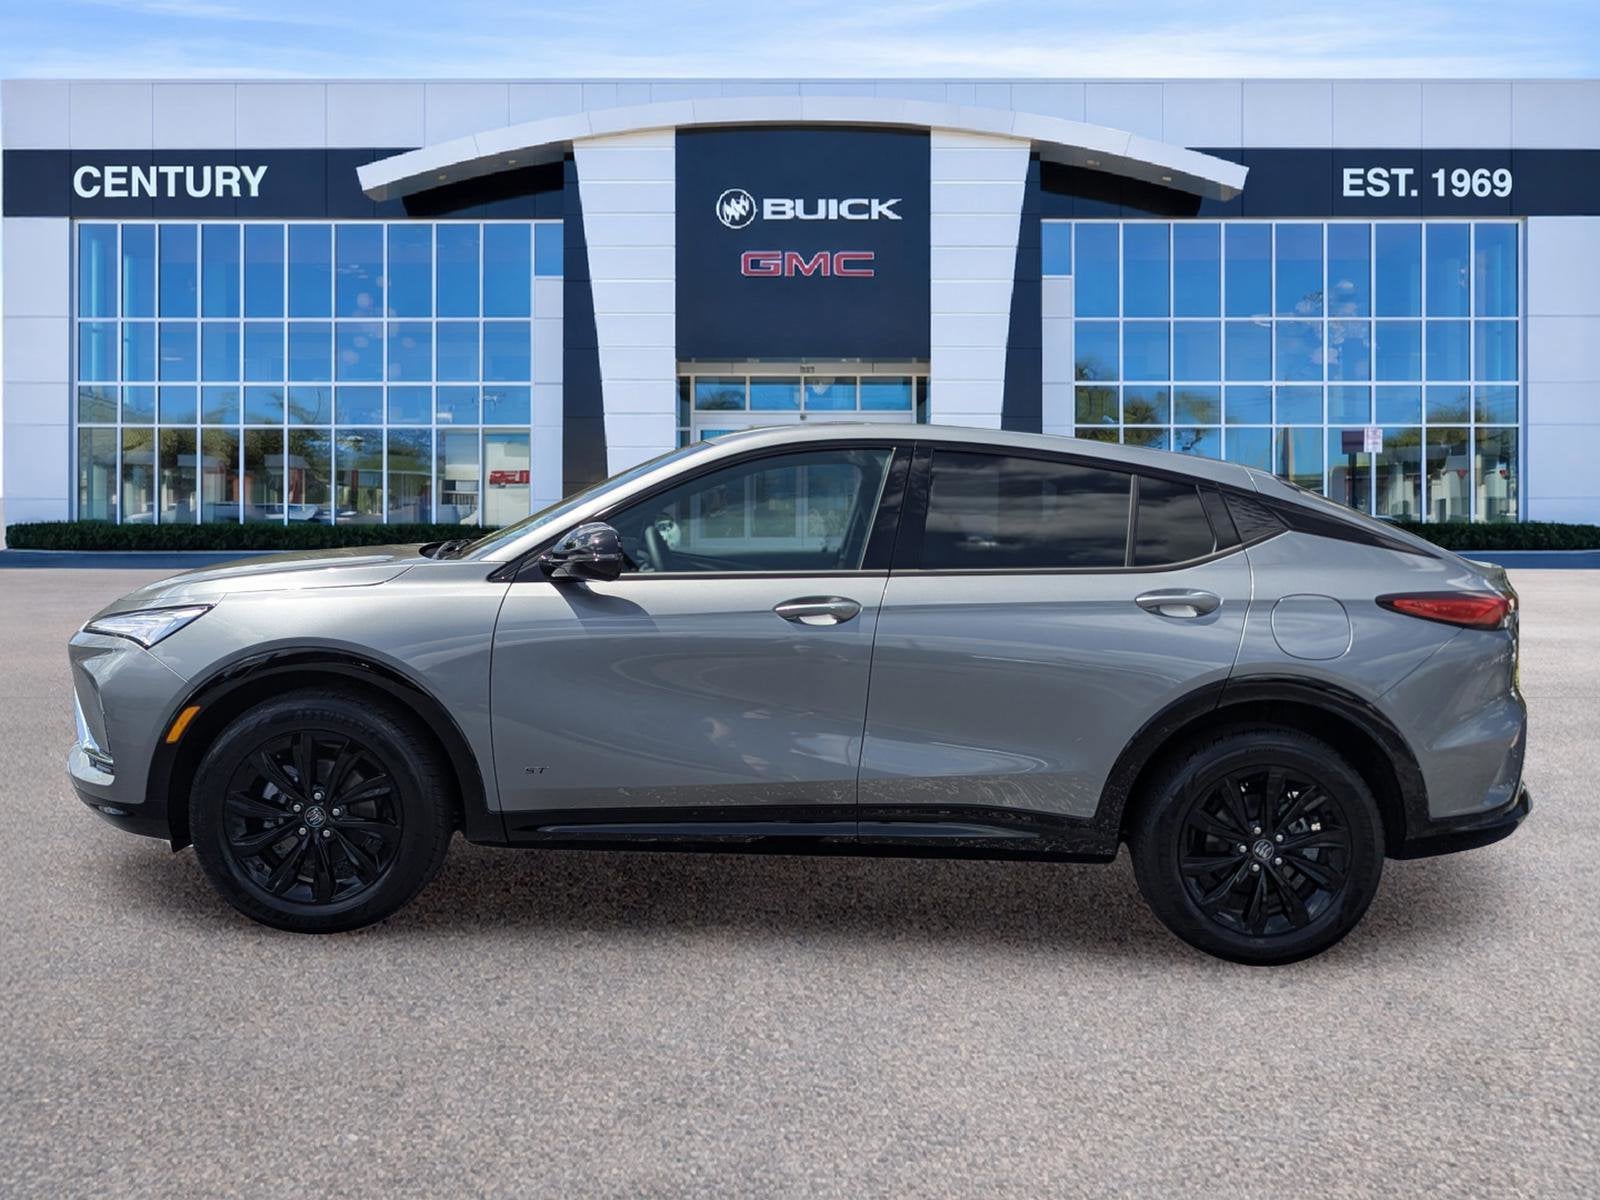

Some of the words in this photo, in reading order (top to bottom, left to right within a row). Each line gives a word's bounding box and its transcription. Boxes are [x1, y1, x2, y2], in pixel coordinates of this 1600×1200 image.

[73, 165, 268, 199] CENTURY
[1342, 167, 1418, 198] EST.
[1431, 167, 1512, 198] 1969
[763, 198, 903, 220] BUICK
[740, 250, 875, 277] GMC
